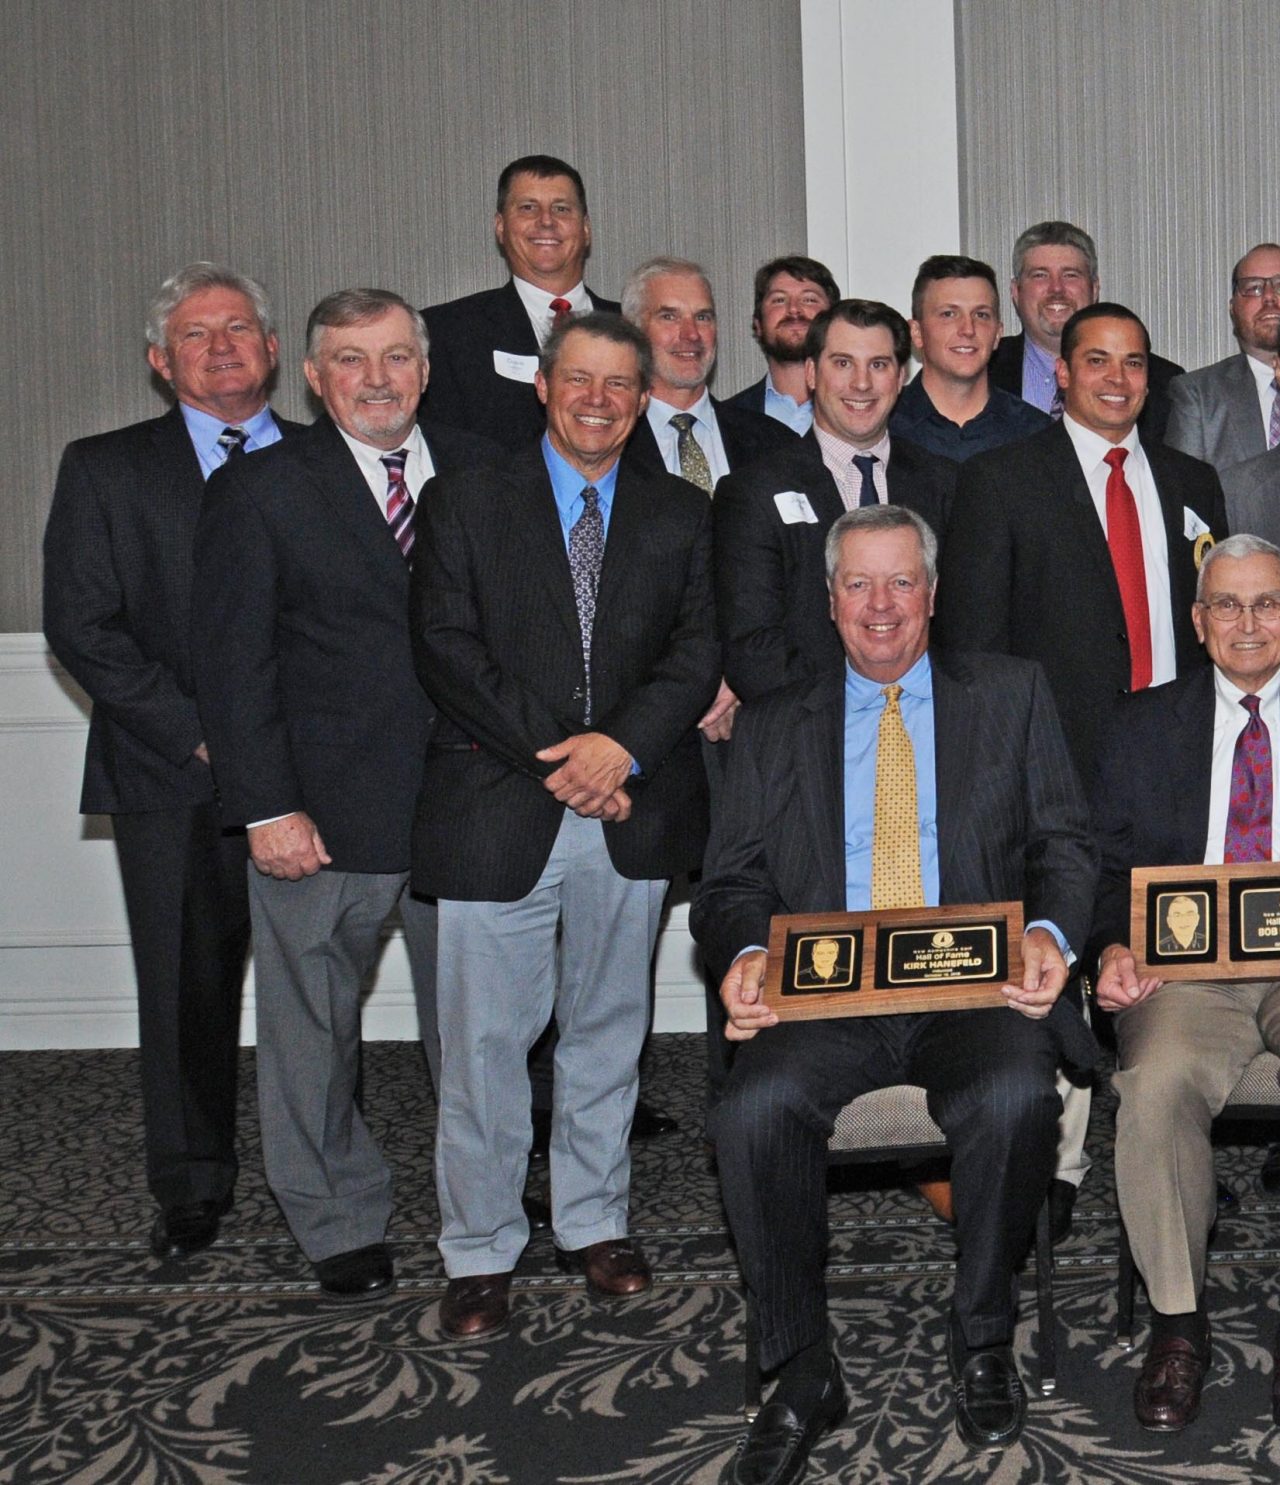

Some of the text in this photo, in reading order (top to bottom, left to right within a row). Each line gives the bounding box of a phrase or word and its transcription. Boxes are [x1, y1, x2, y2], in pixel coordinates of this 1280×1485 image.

[1258, 926, 1278, 937] BOB
[904, 958, 982, 970] KIRK HANEFELD
